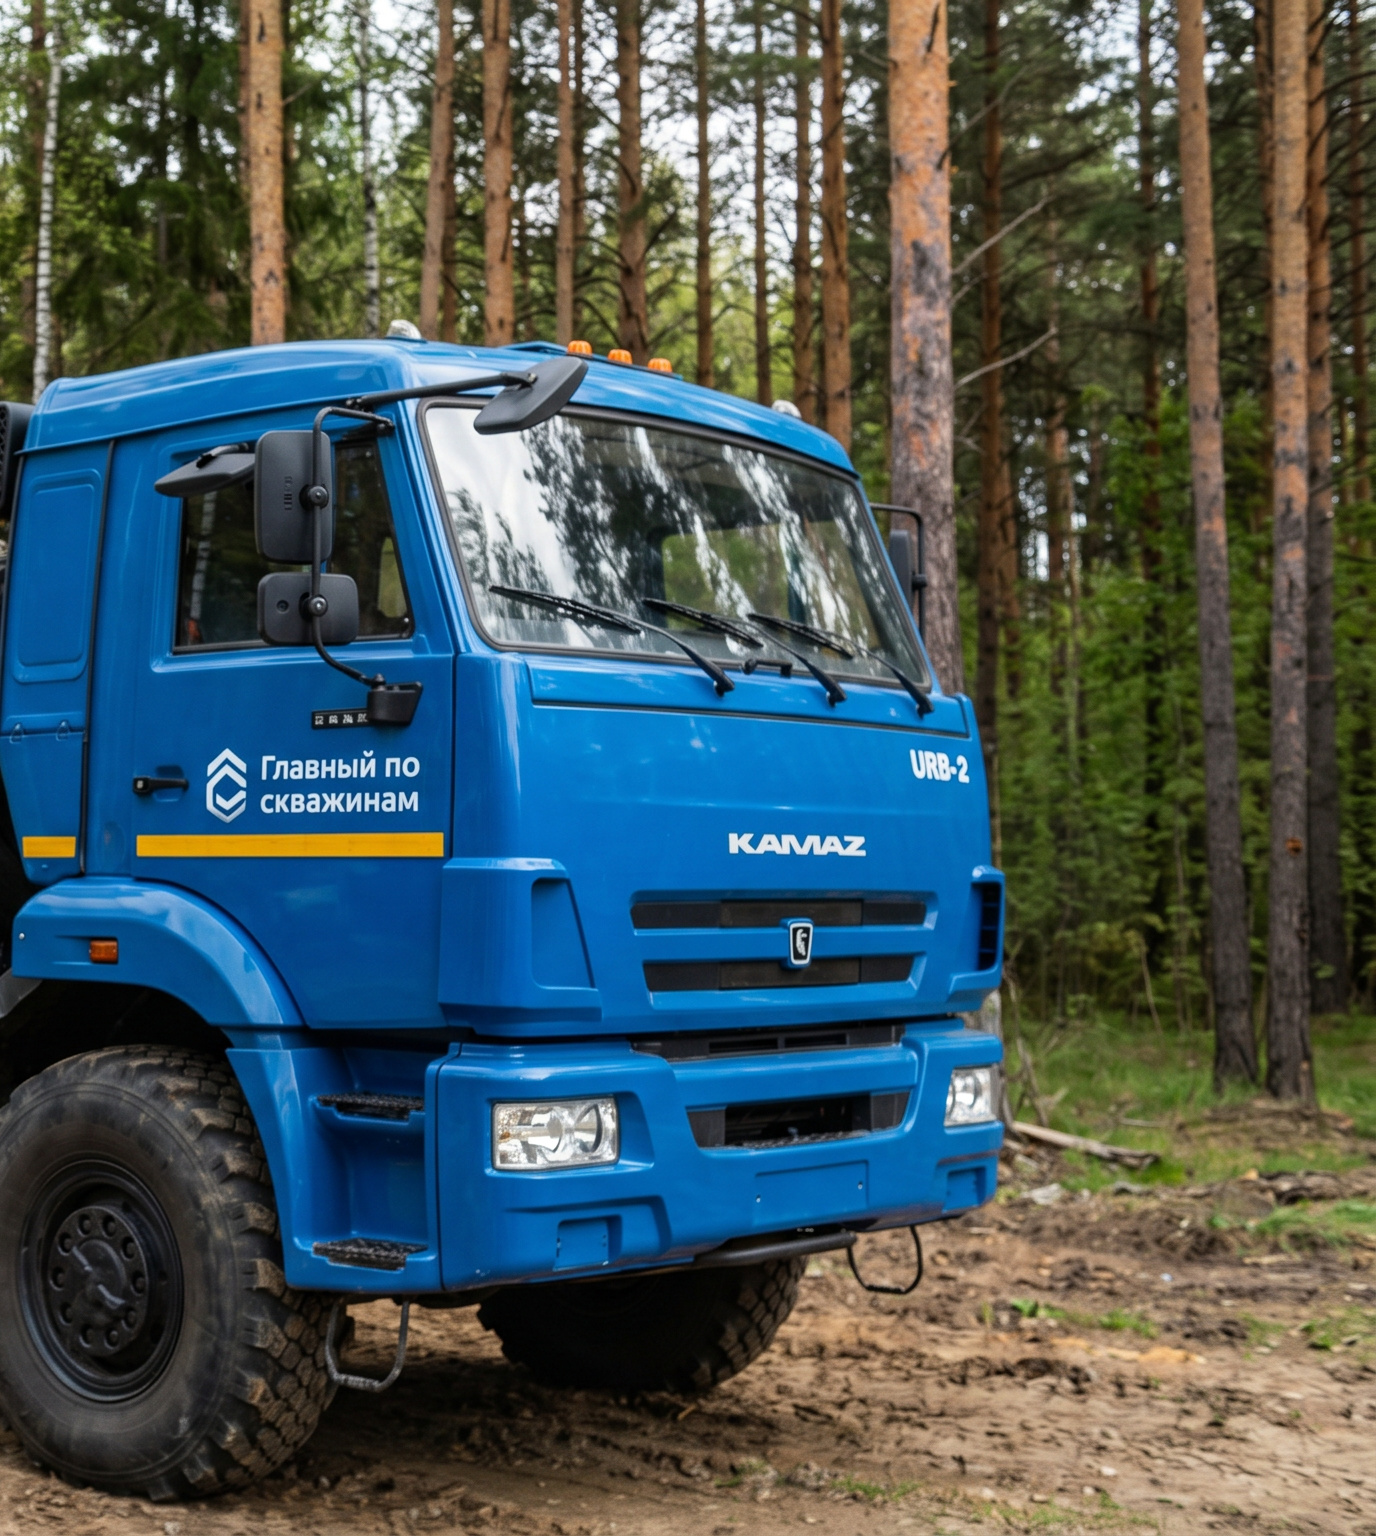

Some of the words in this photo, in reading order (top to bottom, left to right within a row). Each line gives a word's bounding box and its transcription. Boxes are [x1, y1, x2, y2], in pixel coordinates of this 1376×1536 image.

[261, 750, 376, 781] Главный
[385, 757, 421, 778] по
[910, 749, 970, 783] URB-2
[260, 791, 419, 814] скважинам
[729, 833, 867, 857] KAMAZ
